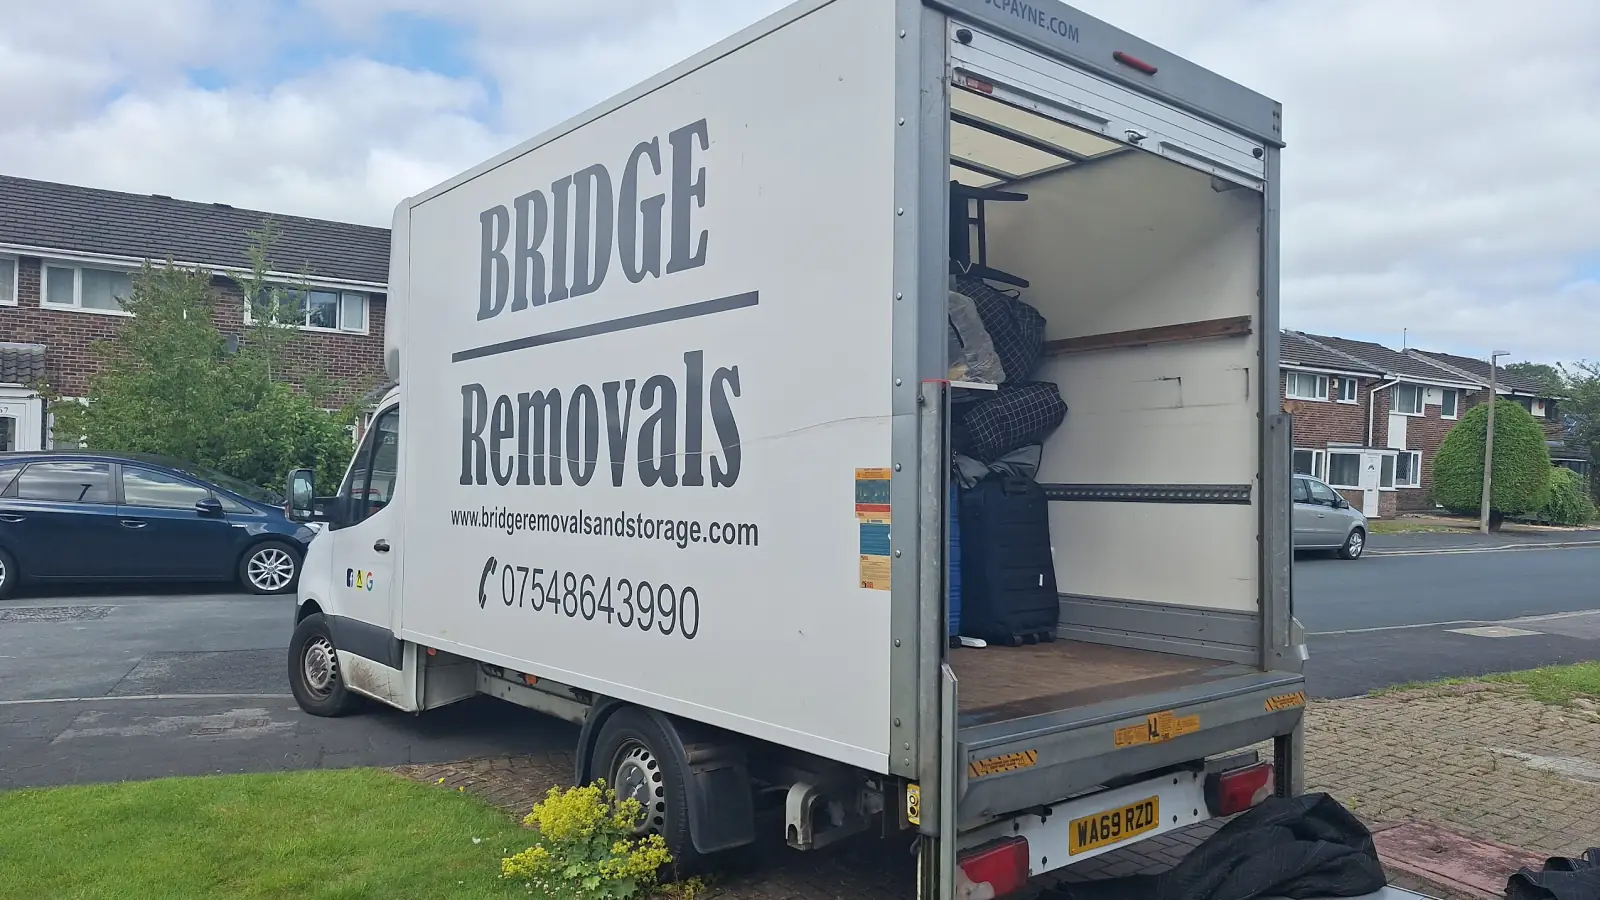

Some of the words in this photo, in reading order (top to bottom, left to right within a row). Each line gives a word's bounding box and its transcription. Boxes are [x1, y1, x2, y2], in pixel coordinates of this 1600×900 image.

[985, 0, 1079, 43] CPAYNE.COM
[477, 118, 710, 322] BRIDGE
[459, 350, 742, 488] Removals
[451, 506, 759, 549] www.bridgeremovalsandstorage.com
[502, 564, 700, 640] 07548643990
[1077, 811, 1121, 848] WA69
[1125, 801, 1153, 833] RZD
